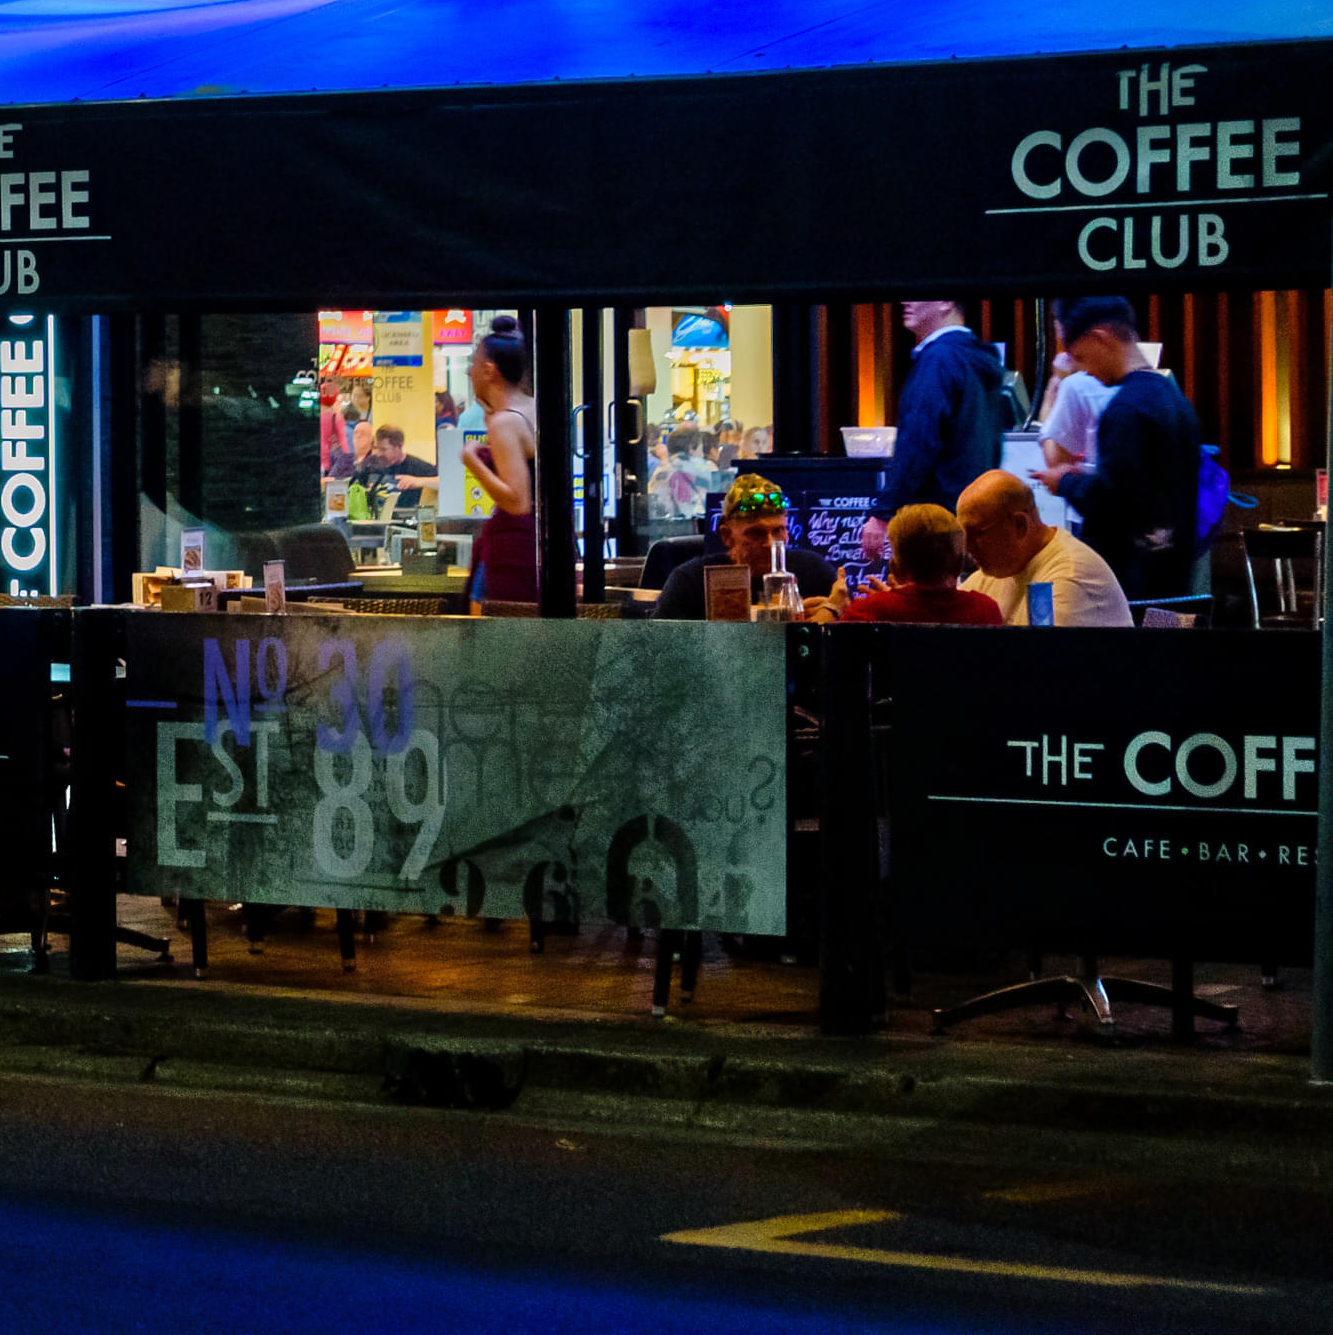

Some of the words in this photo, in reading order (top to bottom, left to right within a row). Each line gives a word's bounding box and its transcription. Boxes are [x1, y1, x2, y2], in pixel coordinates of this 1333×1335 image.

[1116, 62, 1208, 117] THE
[1011, 116, 1301, 199] COFFEE
[1077, 213, 1230, 271] CLUB
[0, 339, 47, 571] COFFEE
[833, 497, 870, 507] COFFEE
[315, 637, 415, 755] 30
[155, 720, 281, 868] EST
[312, 728, 447, 881] 89
[1007, 734, 1105, 786] THE
[1123, 730, 1316, 800] COFF
